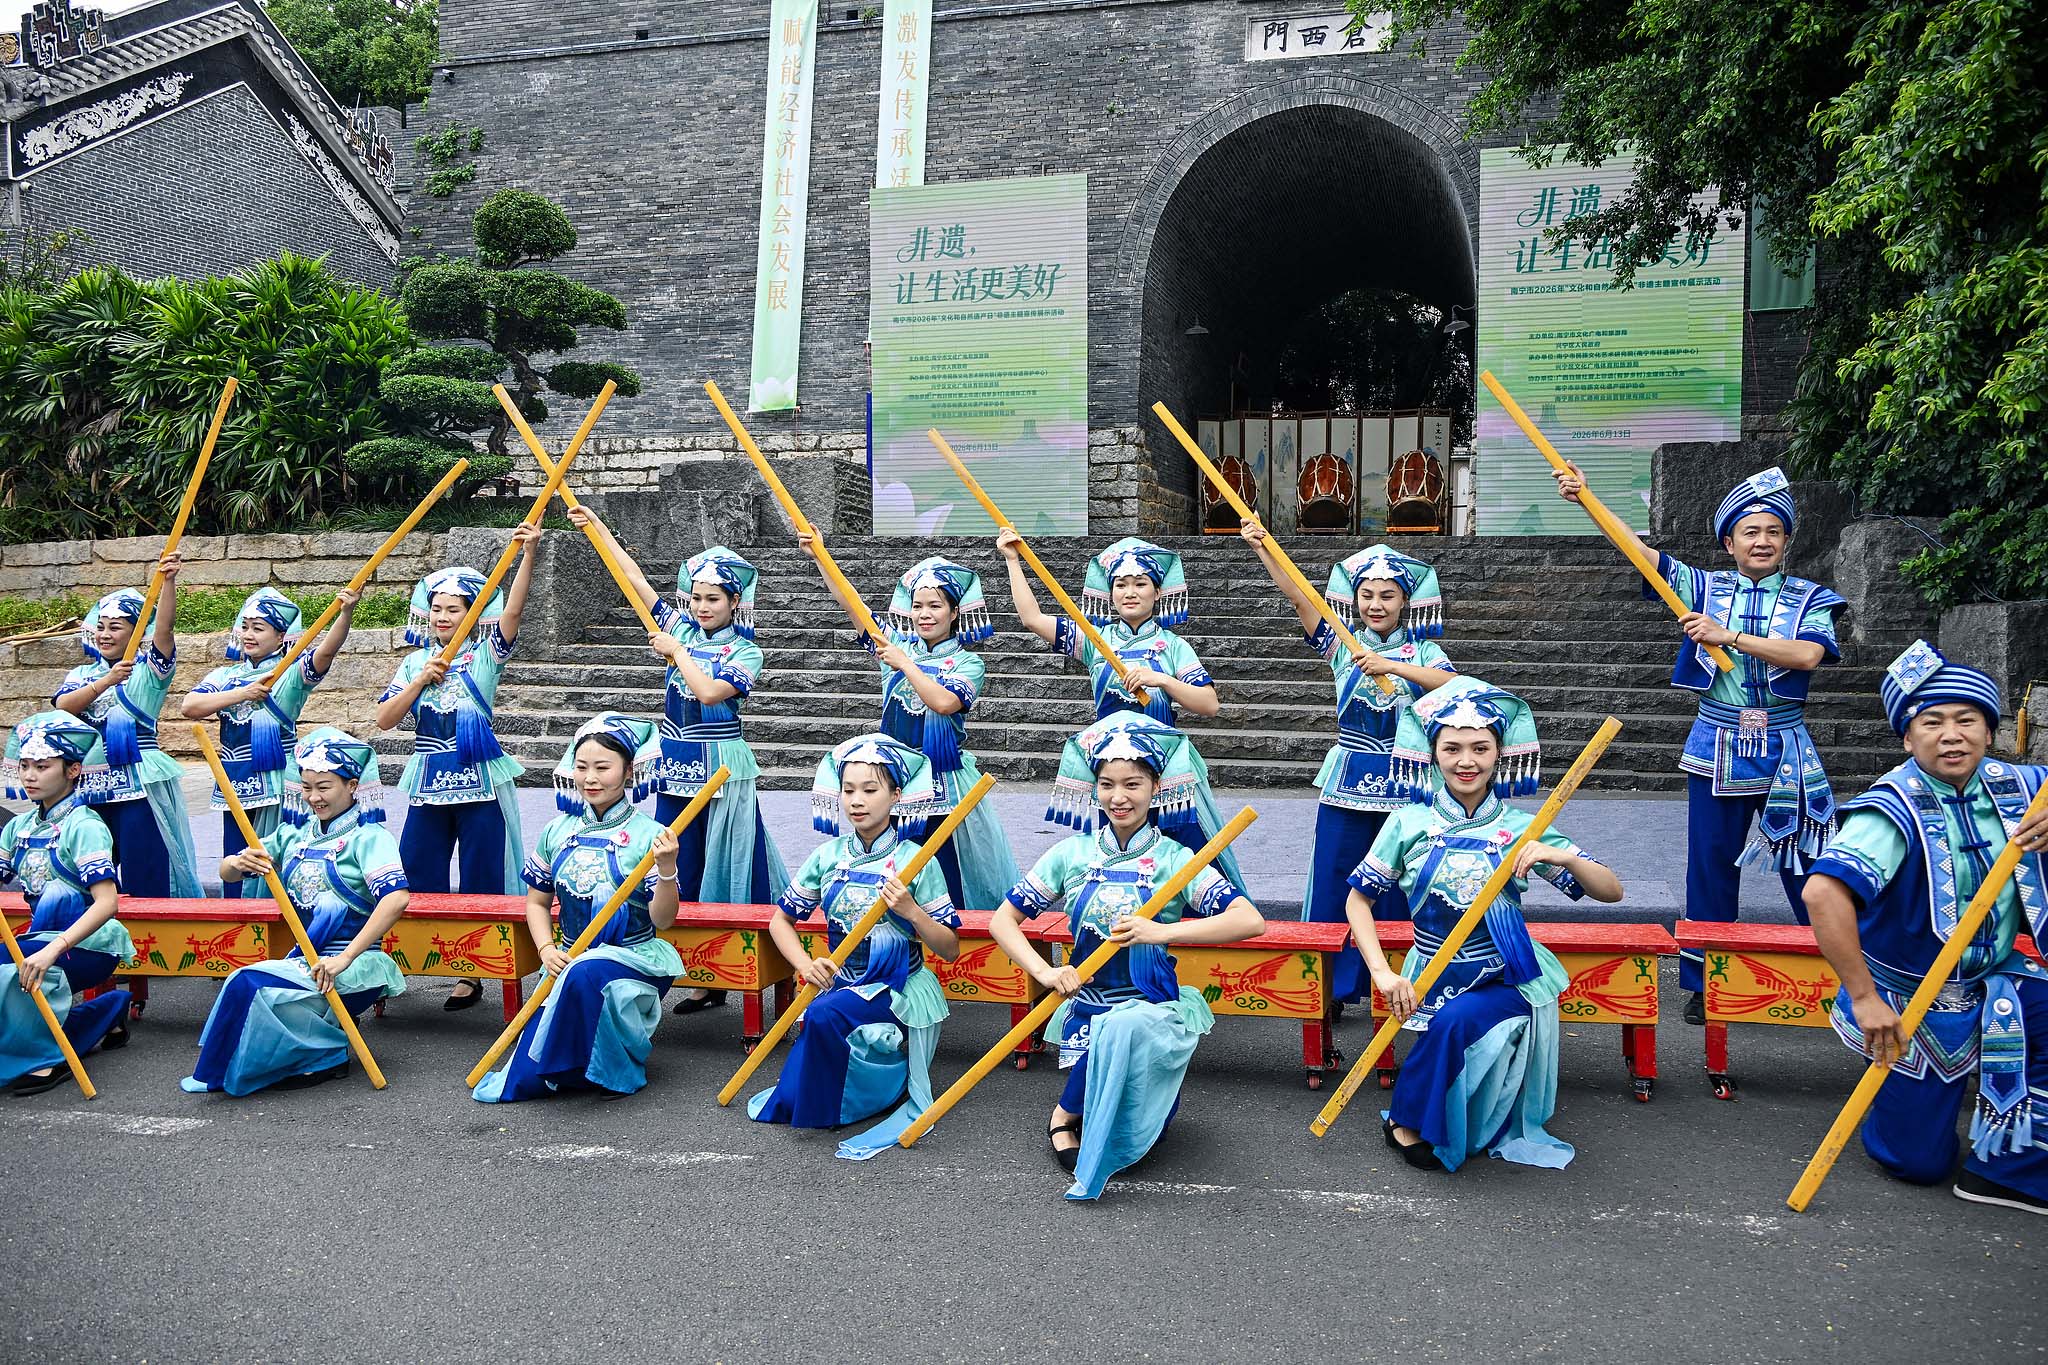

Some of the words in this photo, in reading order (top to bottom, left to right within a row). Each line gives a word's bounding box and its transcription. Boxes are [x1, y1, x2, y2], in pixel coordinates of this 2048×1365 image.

[766, 16, 803, 311] 赋能经济社会发展
[1506, 232, 1725, 274] 让生活美好
[888, 263, 1067, 305] 让生活更美好
[1571, 429, 1632, 439] 2026年6月13日
